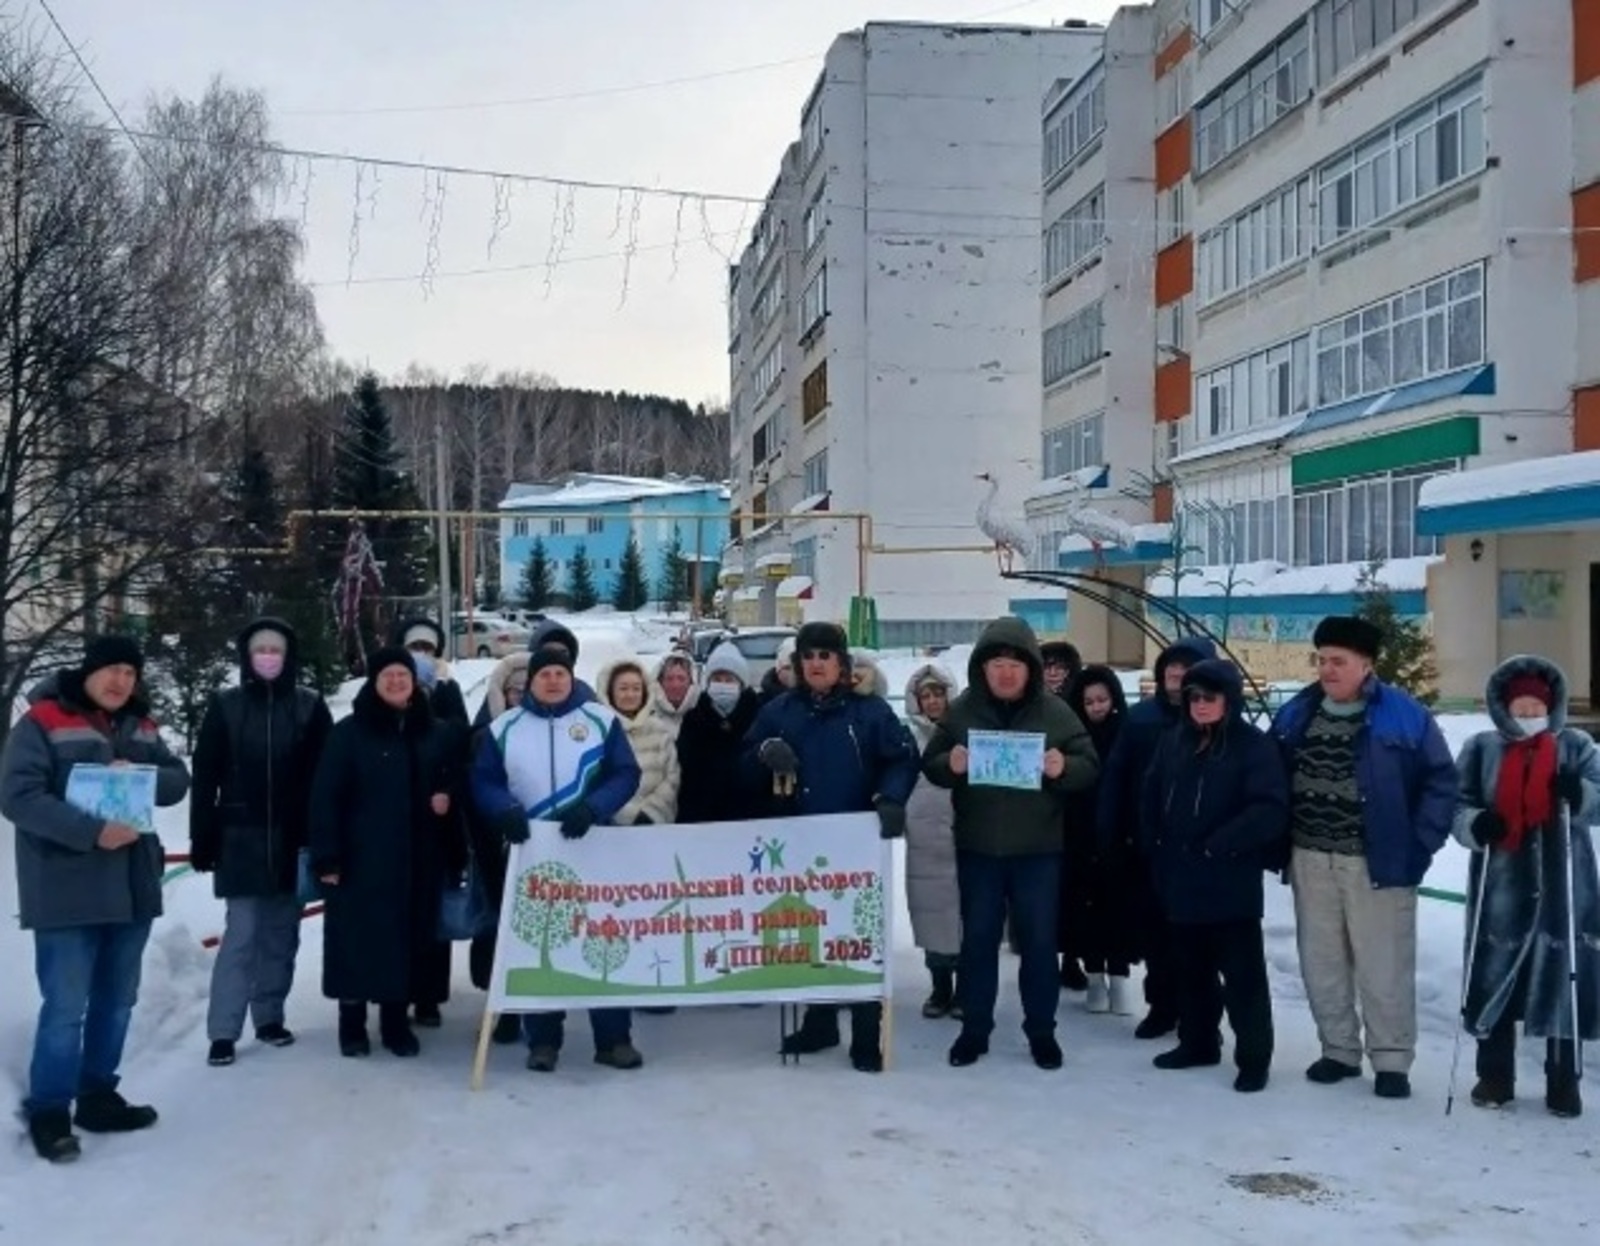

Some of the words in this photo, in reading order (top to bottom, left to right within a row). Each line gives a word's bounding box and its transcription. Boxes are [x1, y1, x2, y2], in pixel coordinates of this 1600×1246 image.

[752, 871, 876, 895] сельсовет
[572, 908, 744, 944] Гафурийский
[752, 908, 828, 936] район
[823, 938, 873, 962] 2025
